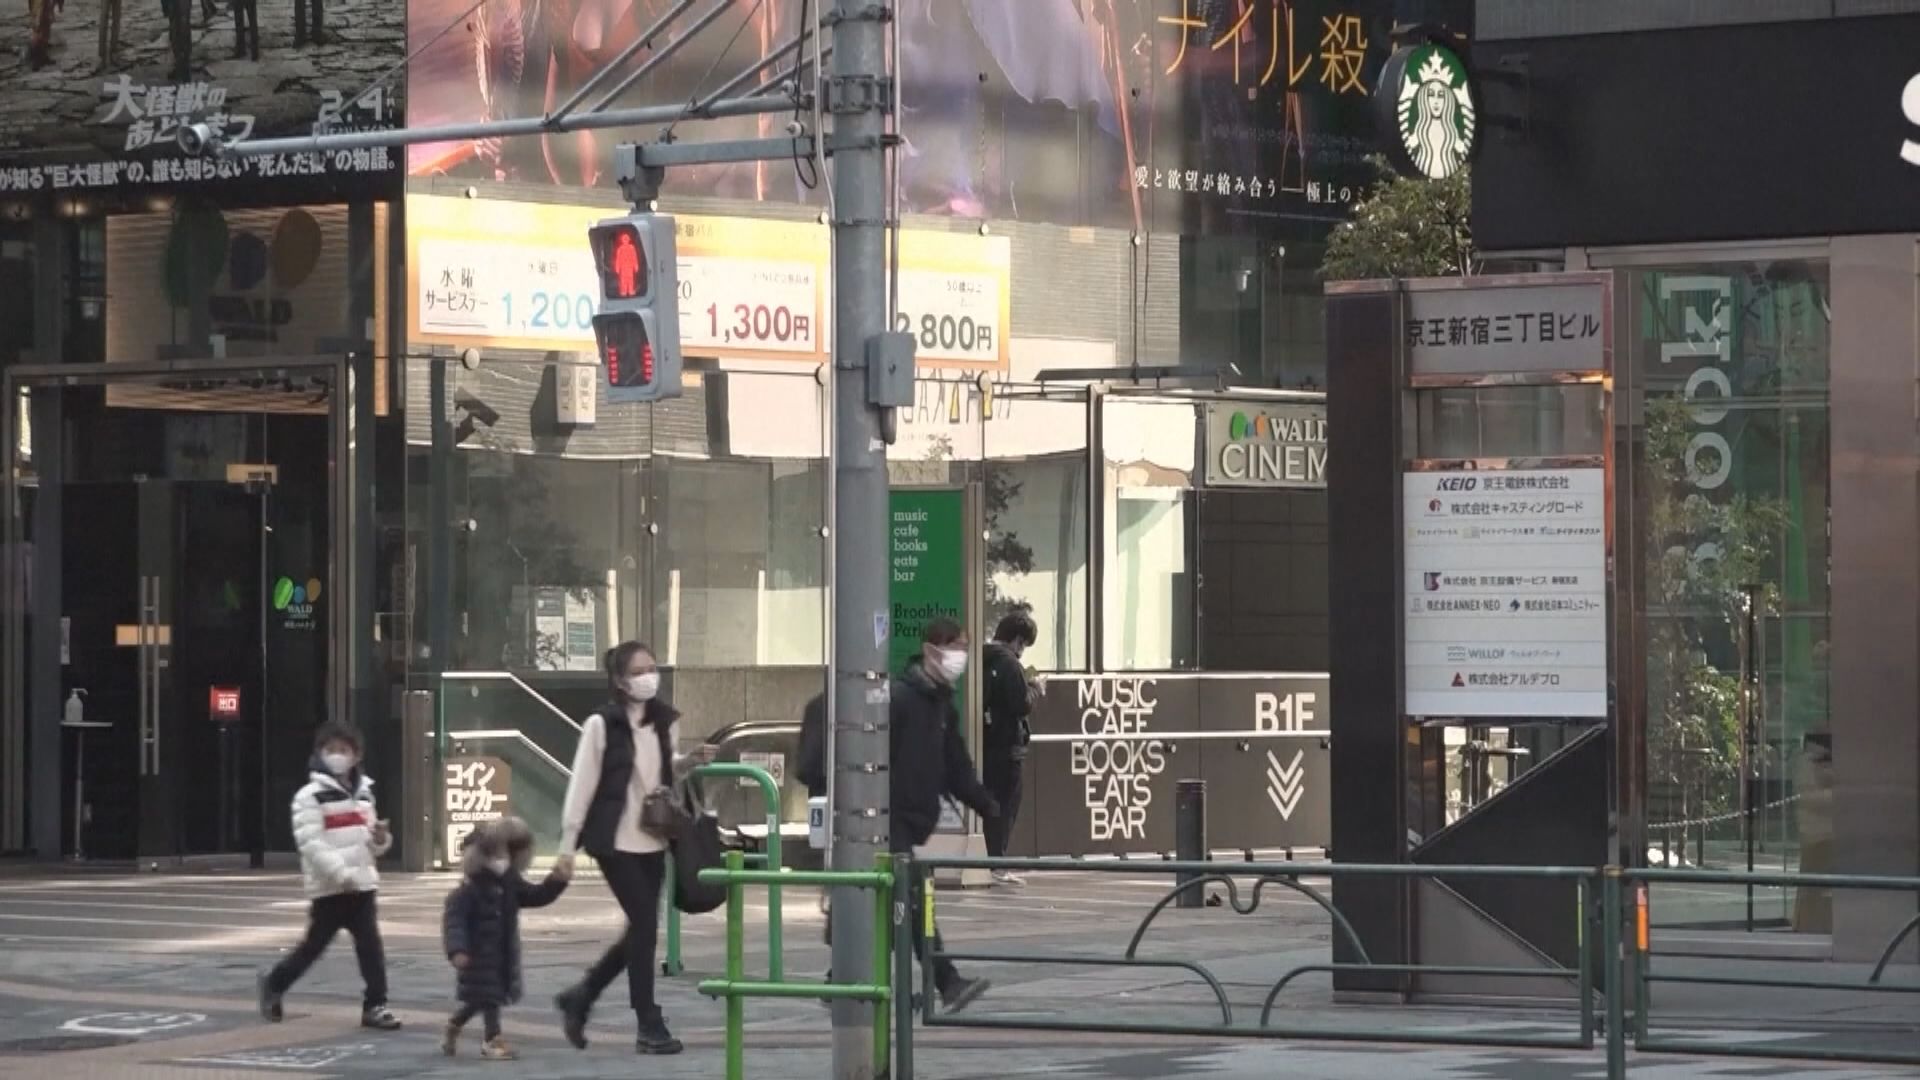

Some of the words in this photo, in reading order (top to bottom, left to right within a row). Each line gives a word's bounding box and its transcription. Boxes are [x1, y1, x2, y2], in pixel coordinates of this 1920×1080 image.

[101, 74, 227, 124] 大怪獣の
[125, 112, 255, 152] あとまつ
[706, 301, 810, 342] 1,300円
[895, 311, 993, 351] 2800円
[1406, 311, 1600, 347] 京王新宿三丁目ビル
[1436, 477, 1477, 492] KEIO
[1482, 475, 1569, 491] 京王電鉄株式会社
[893, 508, 928, 522] music
[1450, 501, 1584, 516] 株式会社キャスティングロード
[893, 524, 919, 537] cafe
[893, 538, 928, 552] books
[893, 555, 919, 567] eats
[893, 568, 916, 582] bar
[1443, 576, 1477, 585] 株式会社
[893, 603, 958, 619] Brooklyn
[1468, 672, 1560, 686] 株式会社アルデプロ
[1078, 678, 1158, 709] MUSIC
[1255, 692, 1316, 732] B1F
[1071, 739, 1166, 775] BOOKS
[446, 761, 496, 787] コイン
[446, 786, 508, 812] ロッカー
[1085, 774, 1152, 808] EATS
[1090, 806, 1147, 840] BAR
